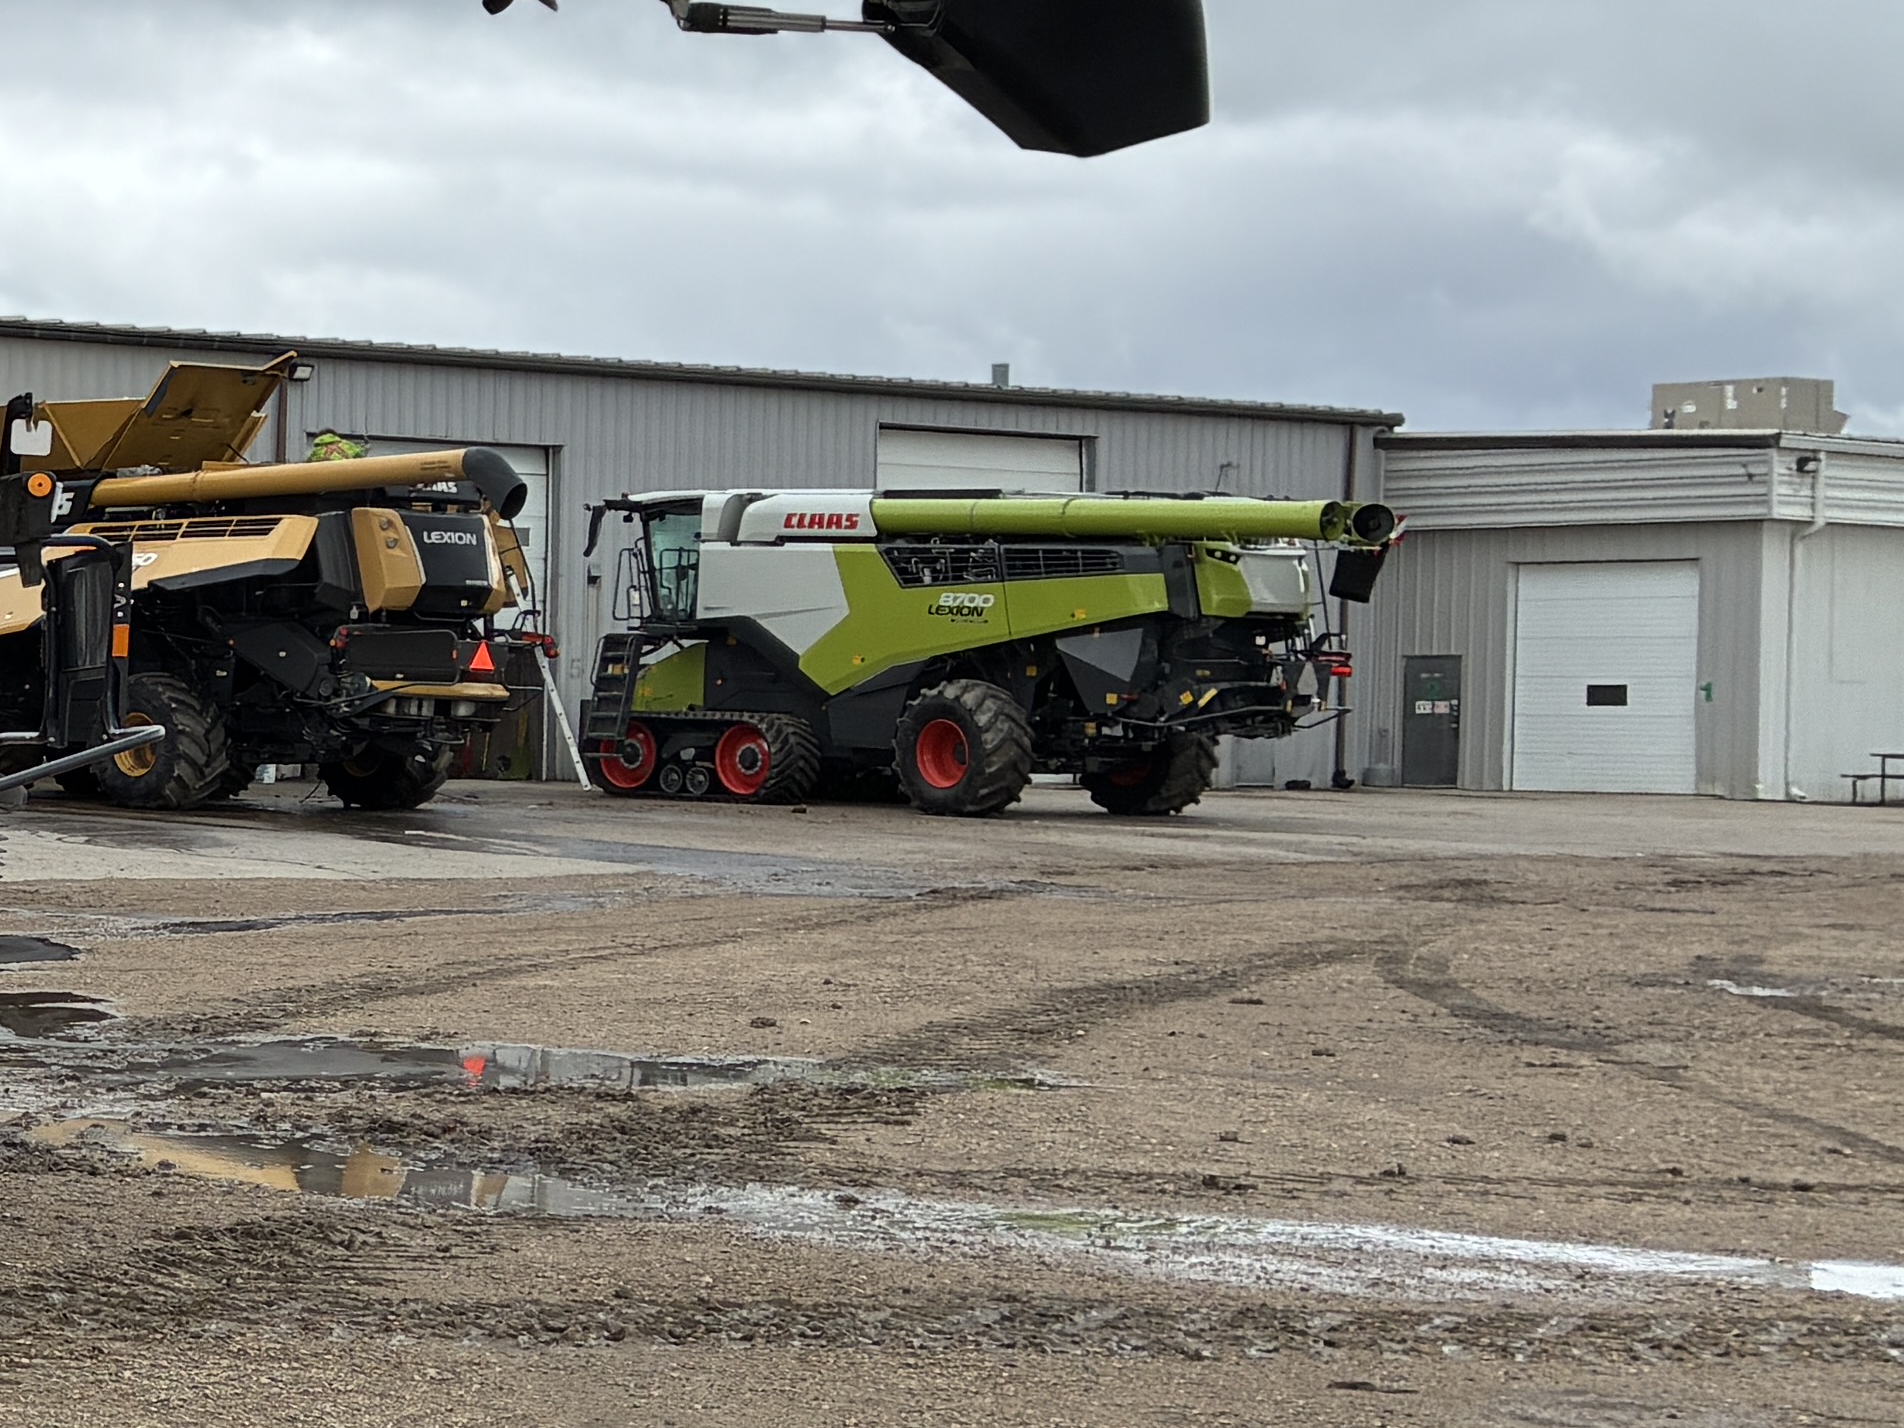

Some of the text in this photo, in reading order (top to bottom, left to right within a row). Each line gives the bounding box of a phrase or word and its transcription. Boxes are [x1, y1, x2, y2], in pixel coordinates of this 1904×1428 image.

[783, 512, 860, 530] CLAAS
[423, 531, 477, 545] LEXION
[939, 593, 994, 607] 8700
